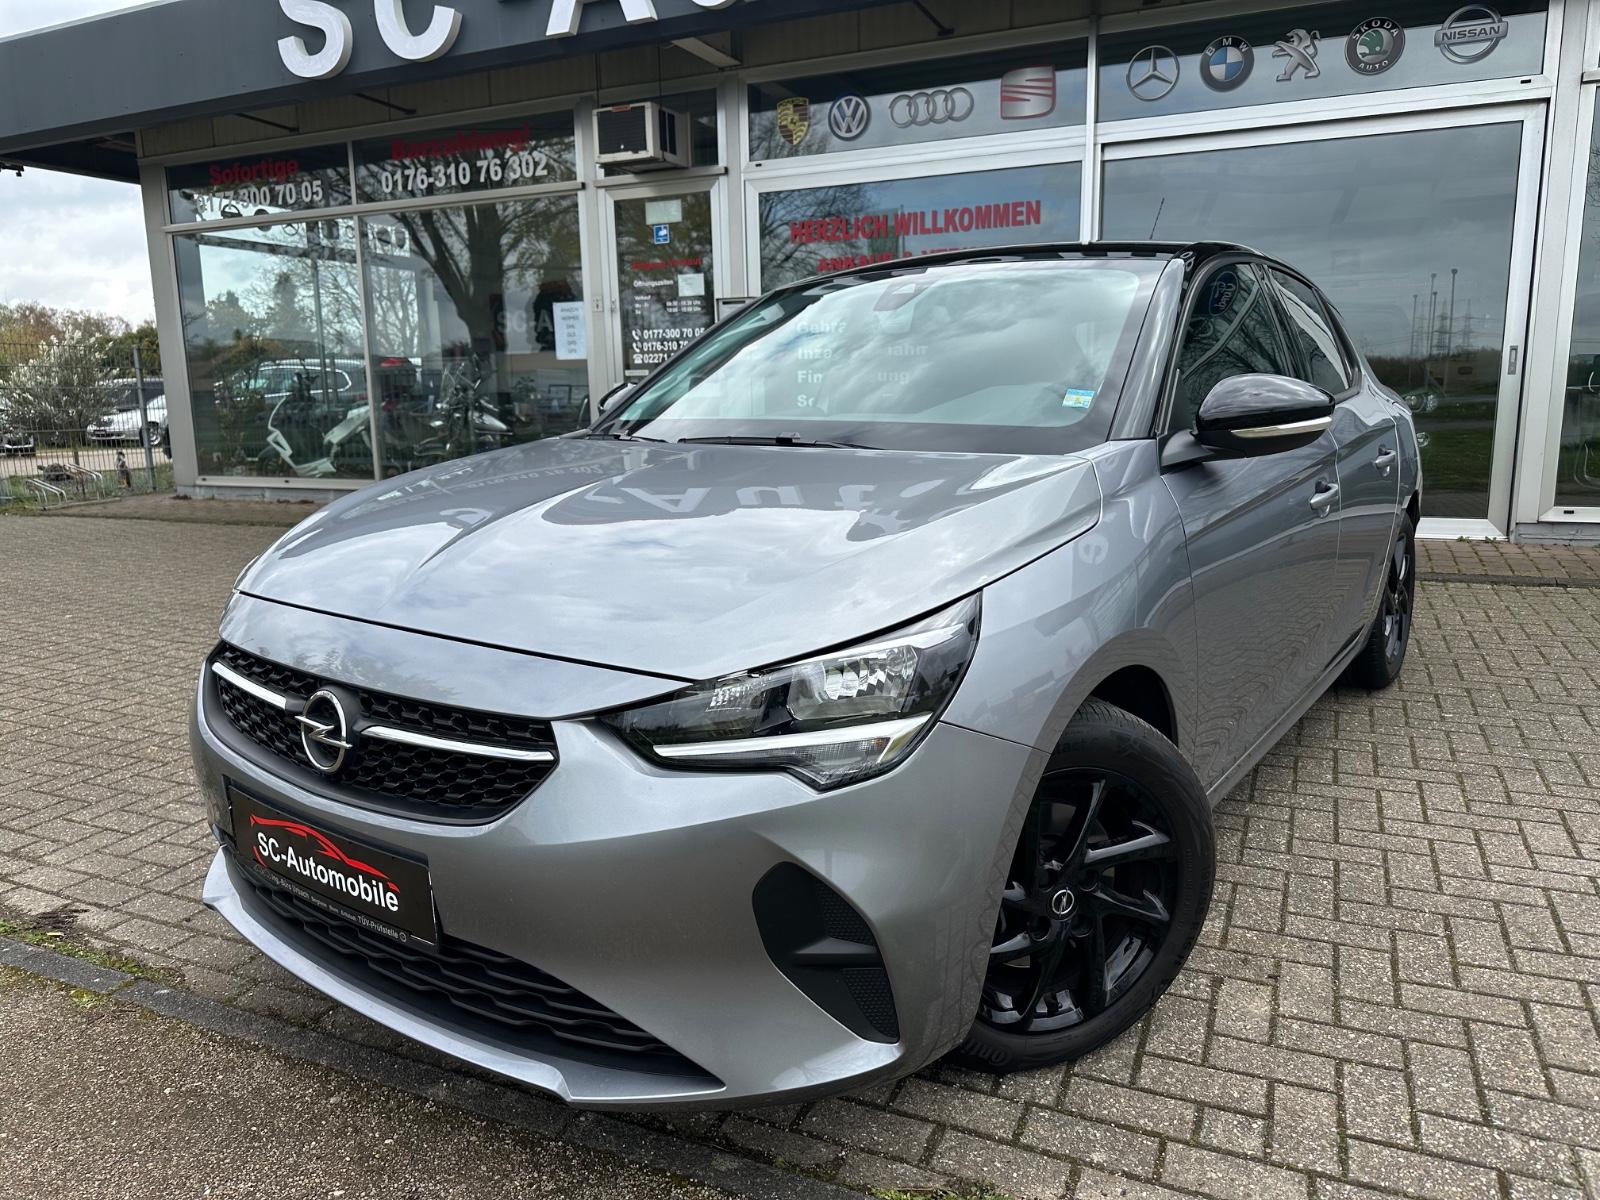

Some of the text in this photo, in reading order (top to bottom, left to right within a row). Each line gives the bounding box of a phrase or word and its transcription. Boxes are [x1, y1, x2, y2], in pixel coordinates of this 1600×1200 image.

[1351, 18, 1399, 41] SKODA
[1441, 24, 1501, 42] NISSAN
[1206, 37, 1249, 56] BMW
[1357, 60, 1390, 71] AUTO
[209, 157, 299, 185] Sofortige
[381, 152, 548, 193] 0176-310 76 302
[275, 183, 296, 205] 70
[302, 180, 323, 202] 05
[790, 200, 1041, 244] HERZLICH WILLKOMMEN
[643, 329, 680, 340] 0177-300
[682, 328, 693, 338] 70
[643, 341, 678, 351] 0176-310
[643, 353, 668, 364] 02271
[257, 831, 399, 912] SC-Automobile
